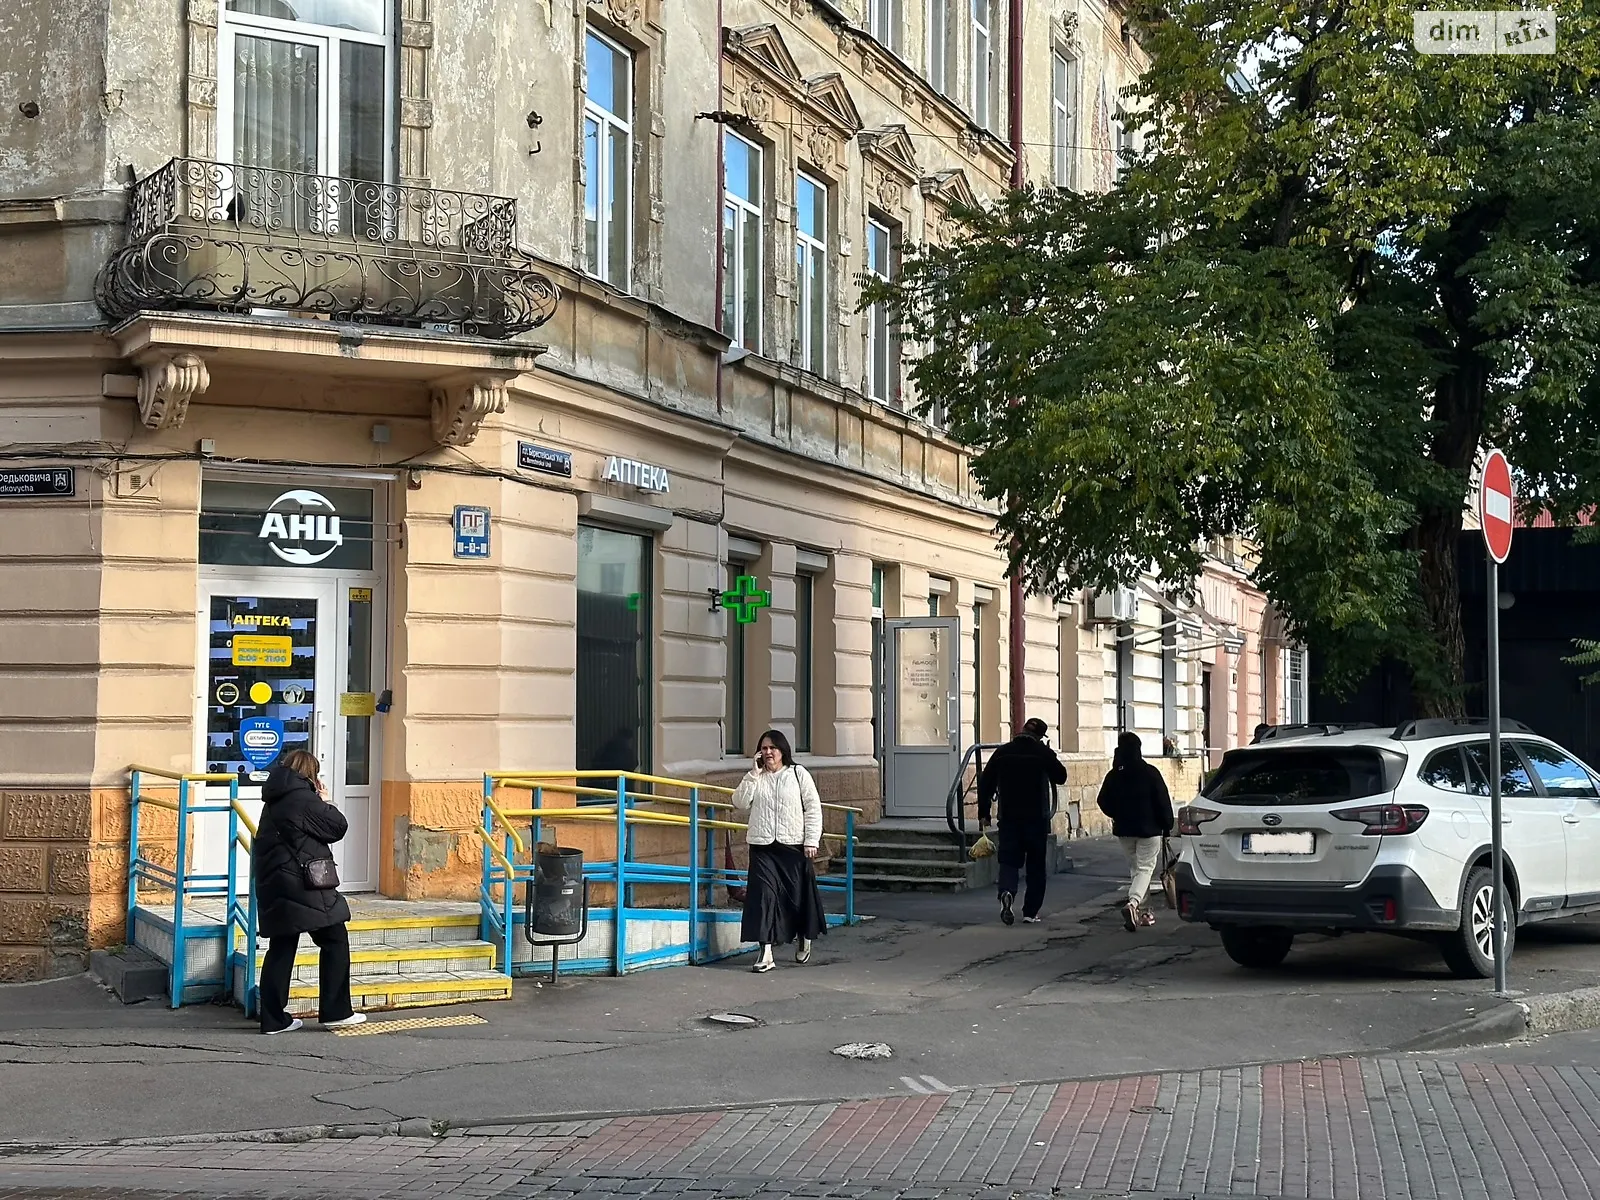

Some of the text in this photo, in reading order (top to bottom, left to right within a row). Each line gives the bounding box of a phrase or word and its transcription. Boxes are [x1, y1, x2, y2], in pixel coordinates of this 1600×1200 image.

[607, 455, 670, 493] АПТЕКА
[0, 485, 34, 493] dkovycha
[258, 512, 343, 546] АНЦ
[233, 615, 292, 627] АПТЕКА
